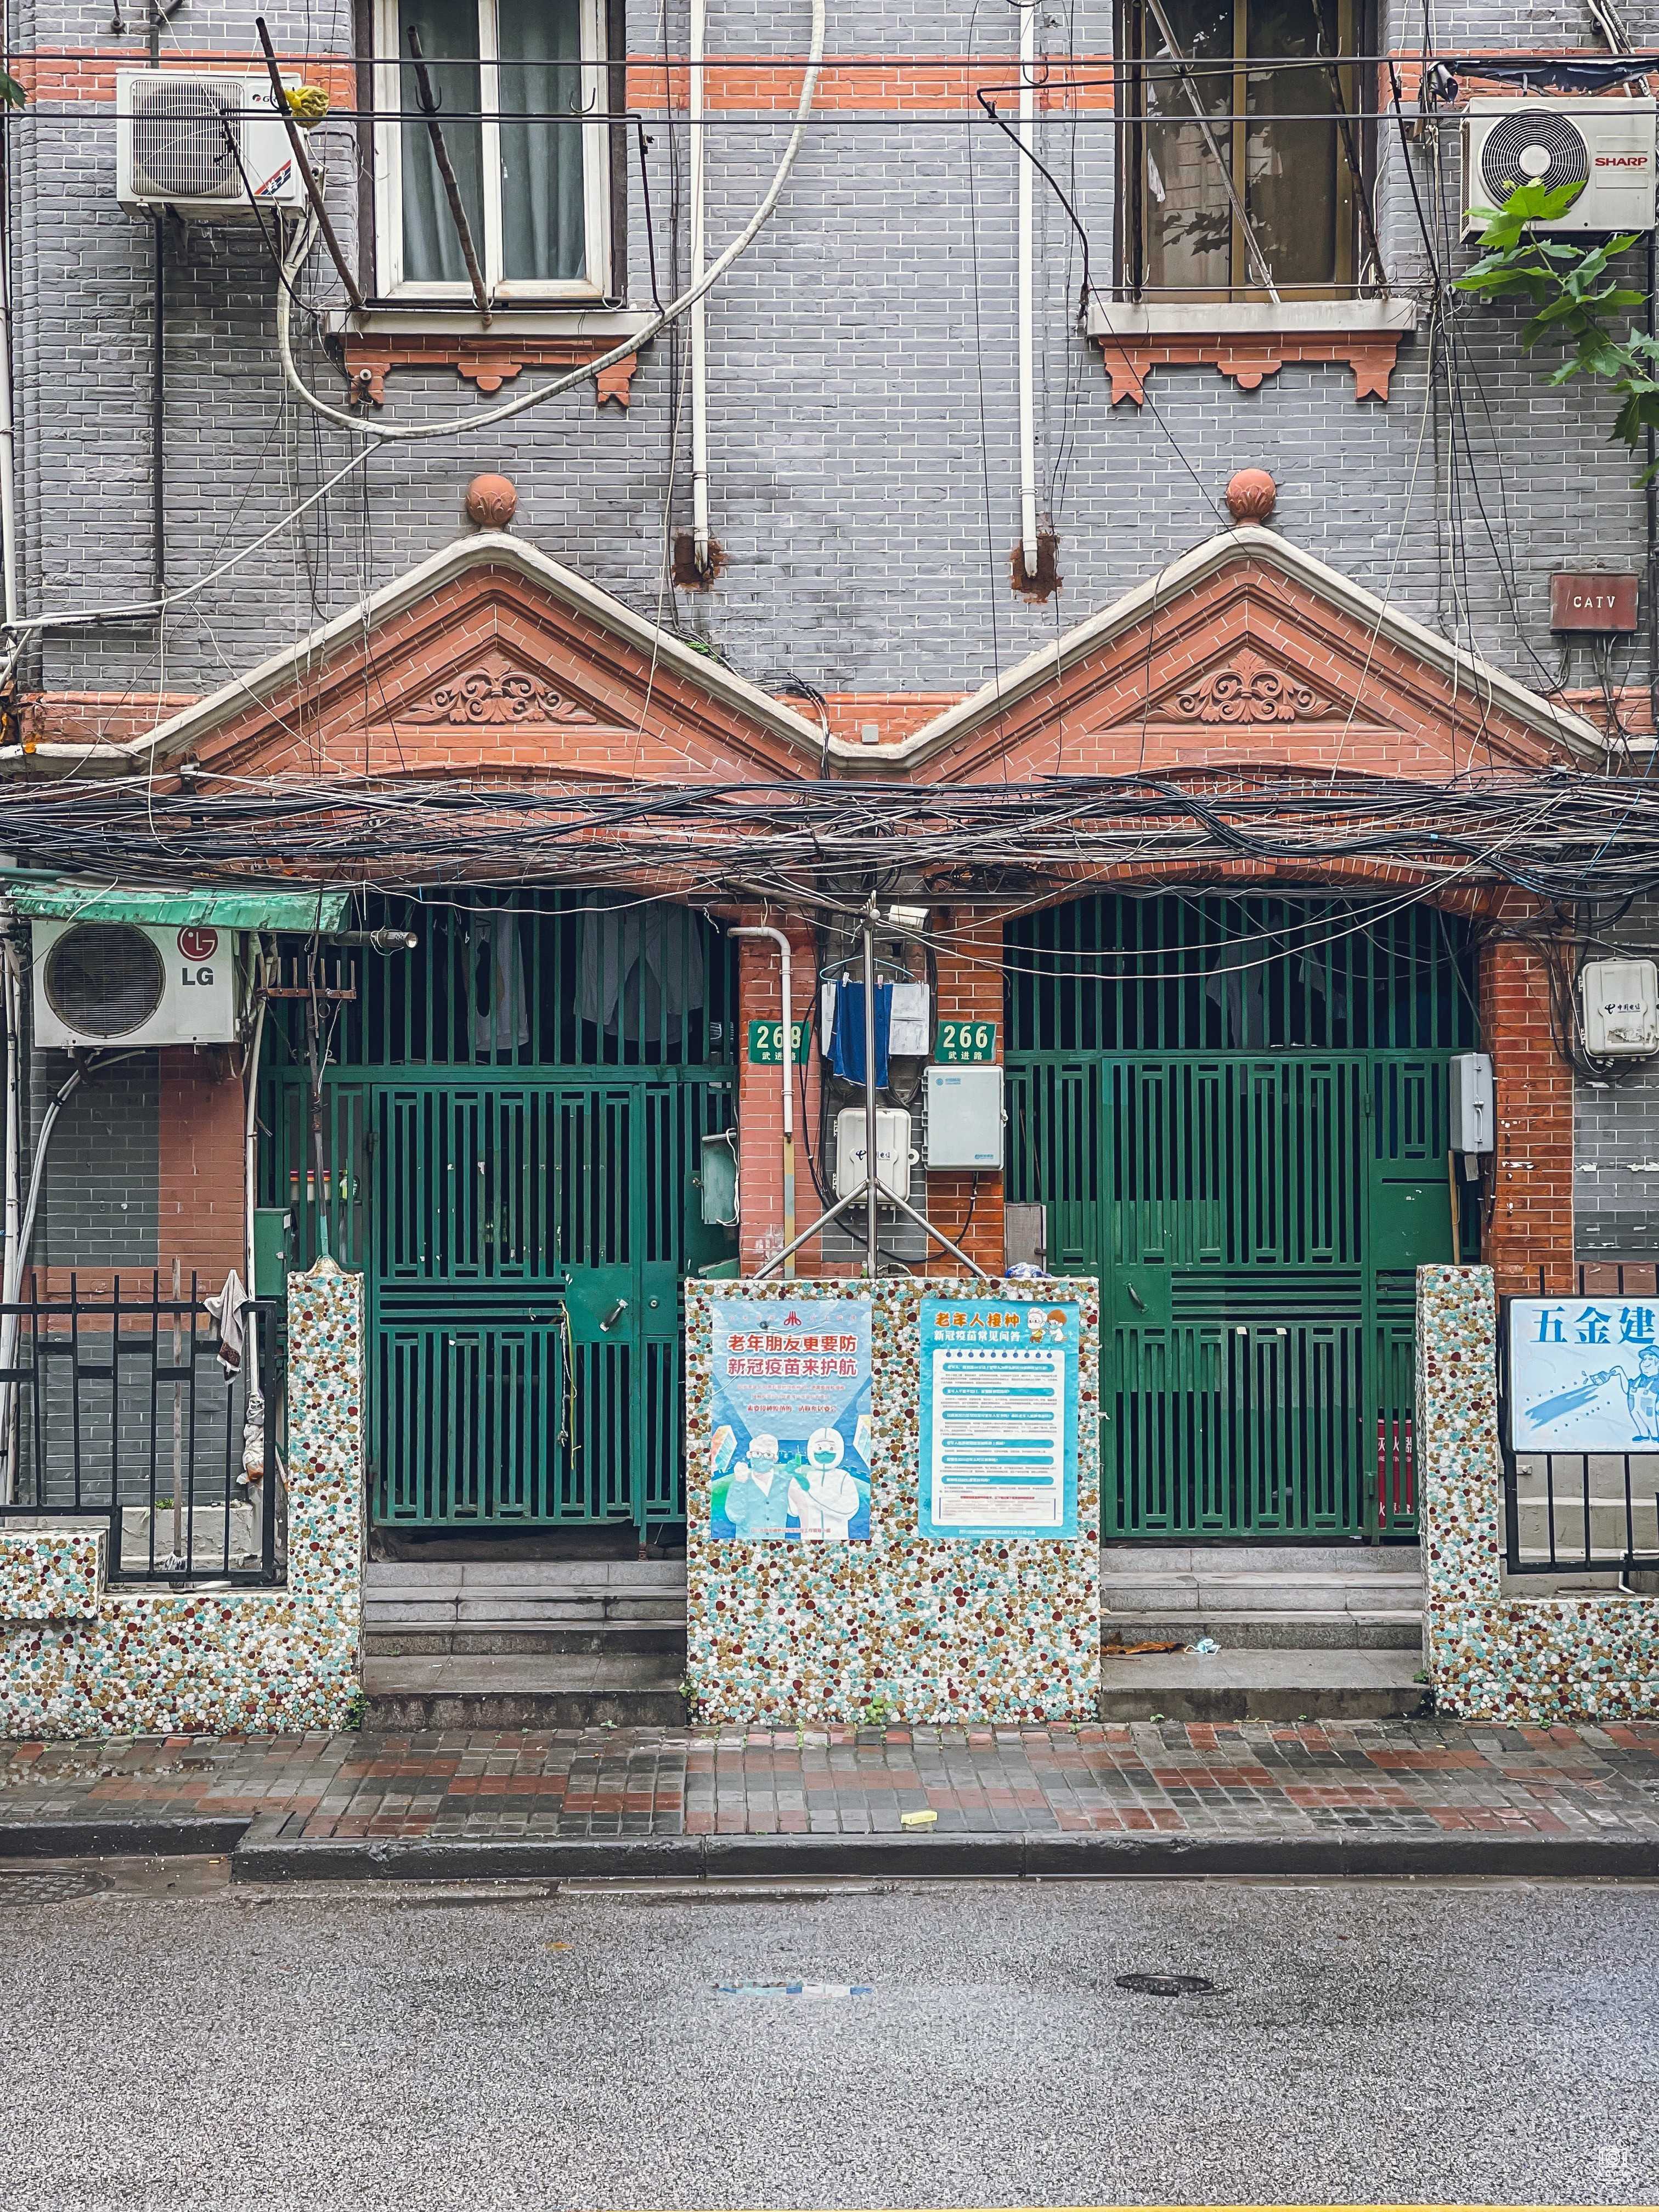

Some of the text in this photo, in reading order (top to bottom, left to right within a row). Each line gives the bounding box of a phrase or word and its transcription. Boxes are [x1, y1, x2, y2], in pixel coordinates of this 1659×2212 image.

[1595, 157, 1647, 166] SHARP
[1573, 596, 1616, 608] CATV
[182, 967, 213, 986] LG
[757, 1025, 801, 1048] 268
[944, 1025, 988, 1048] 266
[948, 1051, 983, 1060] 武进路
[934, 1311, 1020, 1328] 老年人接种
[1530, 1306, 1656, 1345] 五金建
[728, 1334, 857, 1352] 老年朋友更要防
[934, 1330, 1021, 1342] 新冠疫苗常见问答
[728, 1358, 857, 1376] 新冠疫苗来护航
